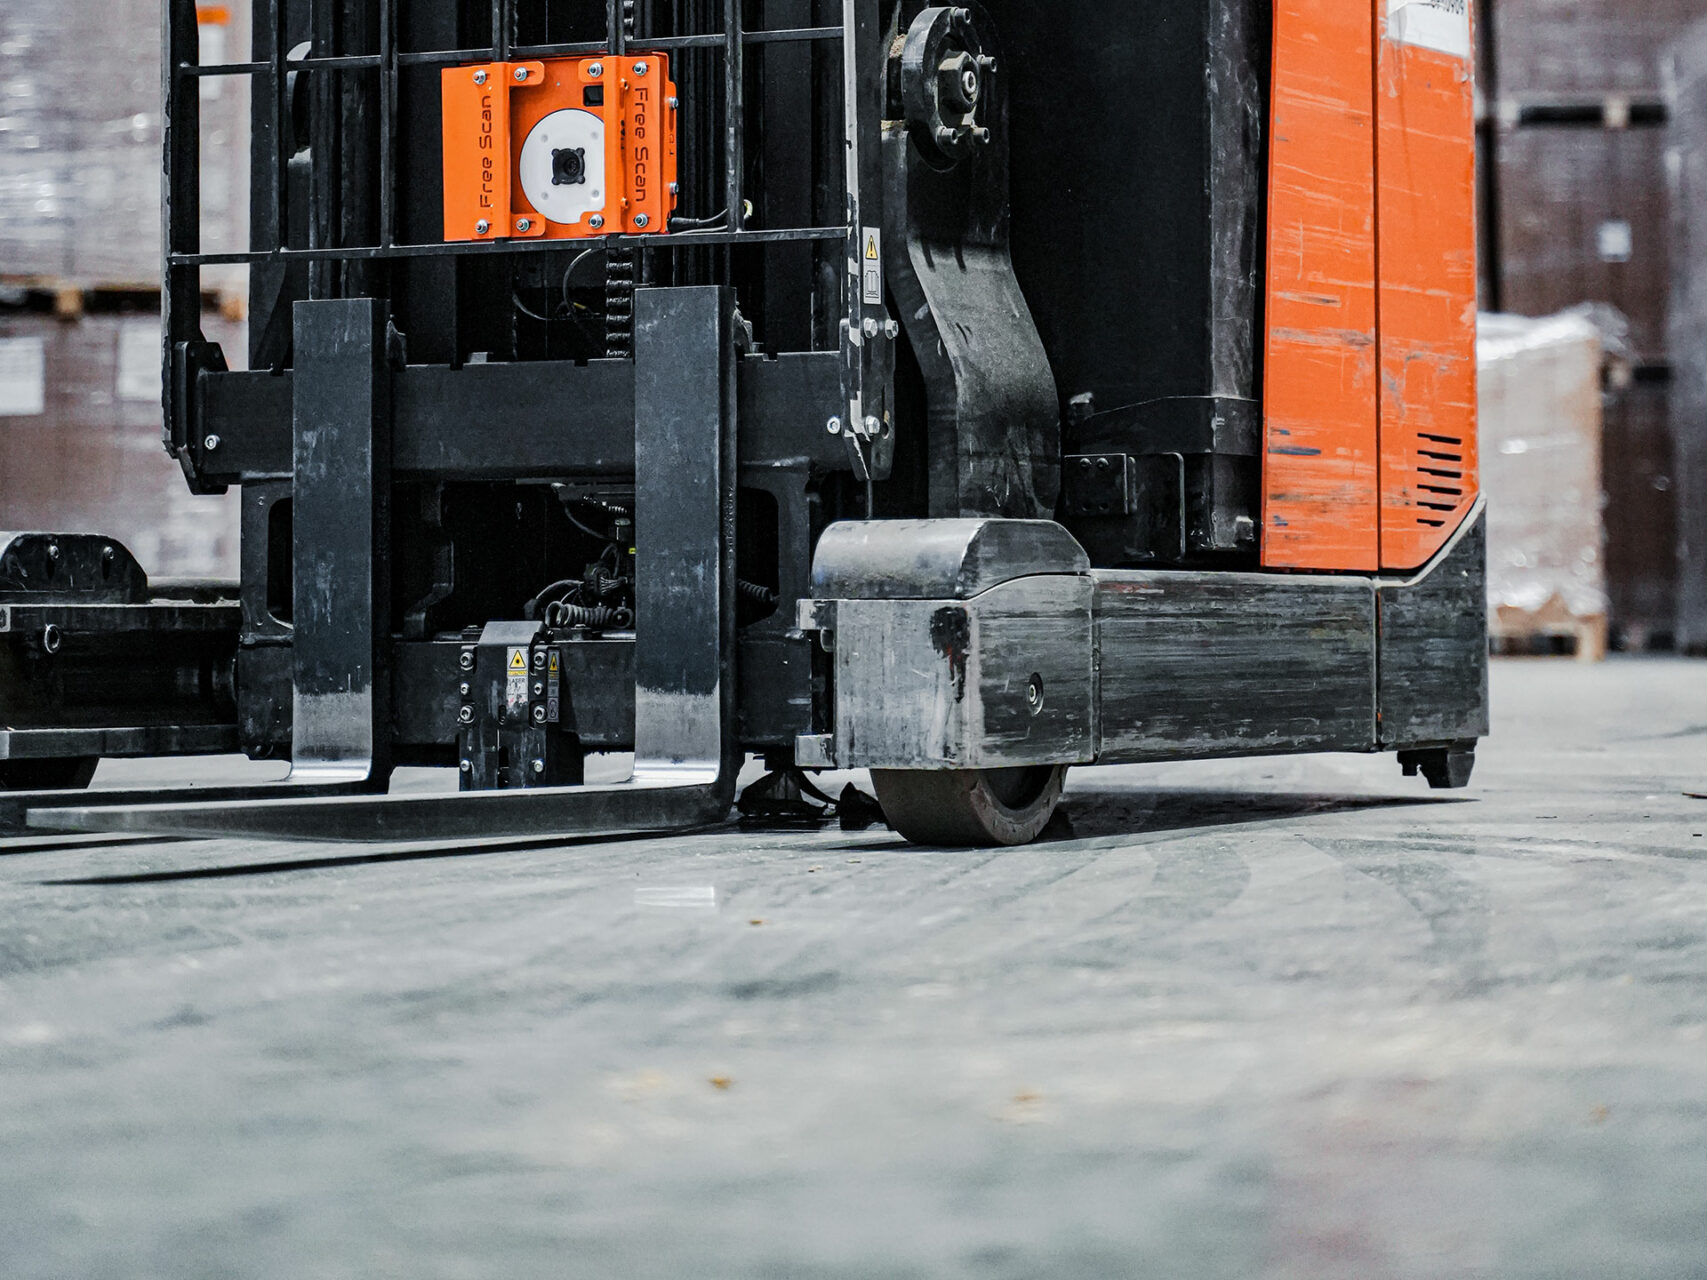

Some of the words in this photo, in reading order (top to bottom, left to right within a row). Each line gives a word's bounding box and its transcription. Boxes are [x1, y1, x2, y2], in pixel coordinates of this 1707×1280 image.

[479, 94, 493, 149] Scan
[635, 87, 648, 140] Free
[480, 156, 493, 209] Free
[635, 146, 649, 203] Scan
